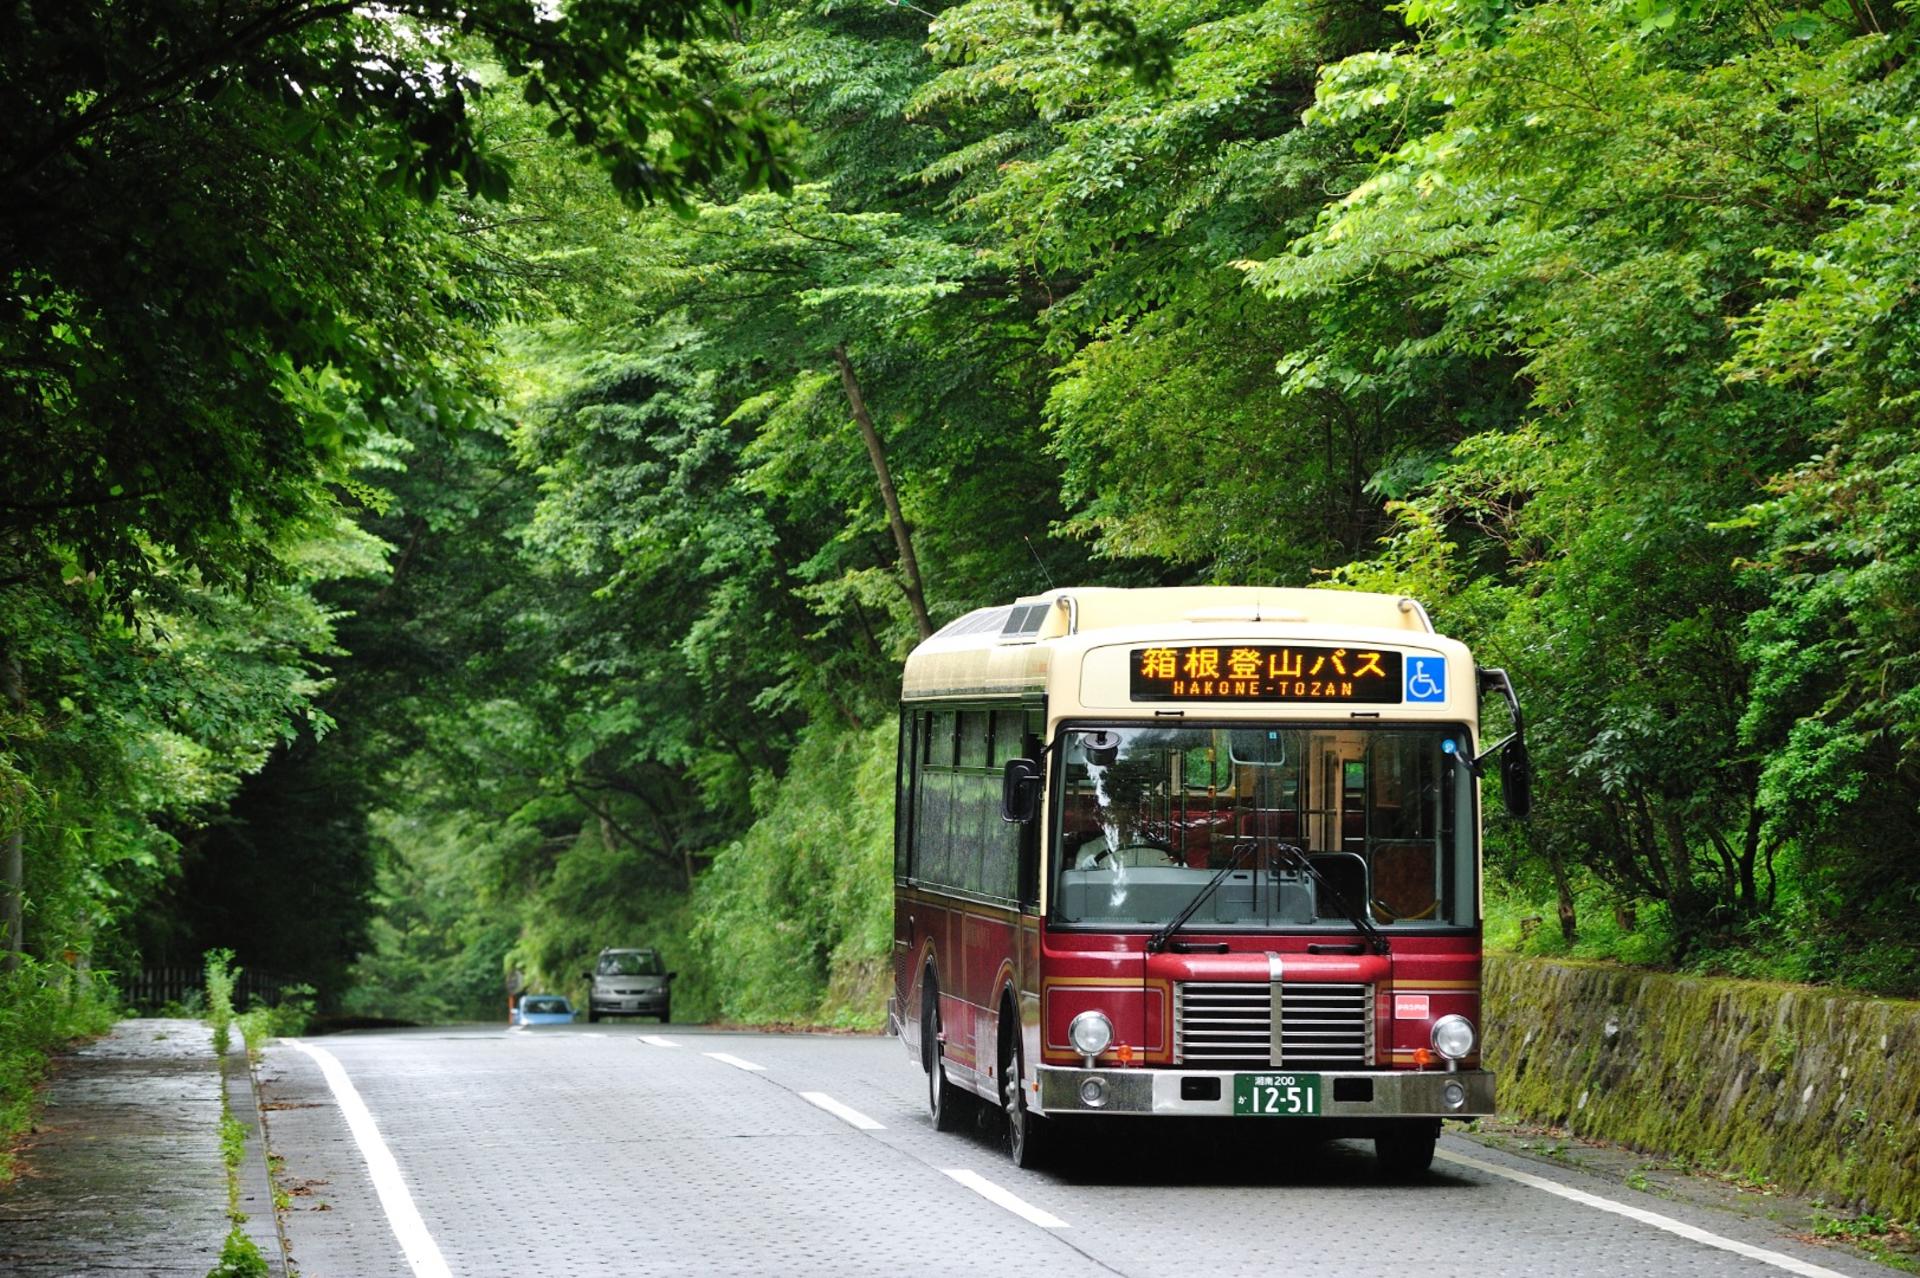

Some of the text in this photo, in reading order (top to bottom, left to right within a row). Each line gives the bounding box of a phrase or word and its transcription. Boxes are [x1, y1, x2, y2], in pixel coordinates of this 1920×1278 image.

[1141, 647, 1386, 679] 箱根登山バス
[1173, 681, 1354, 696] HAKONE-TOZAN
[1253, 1087, 1313, 1113] 12-51
